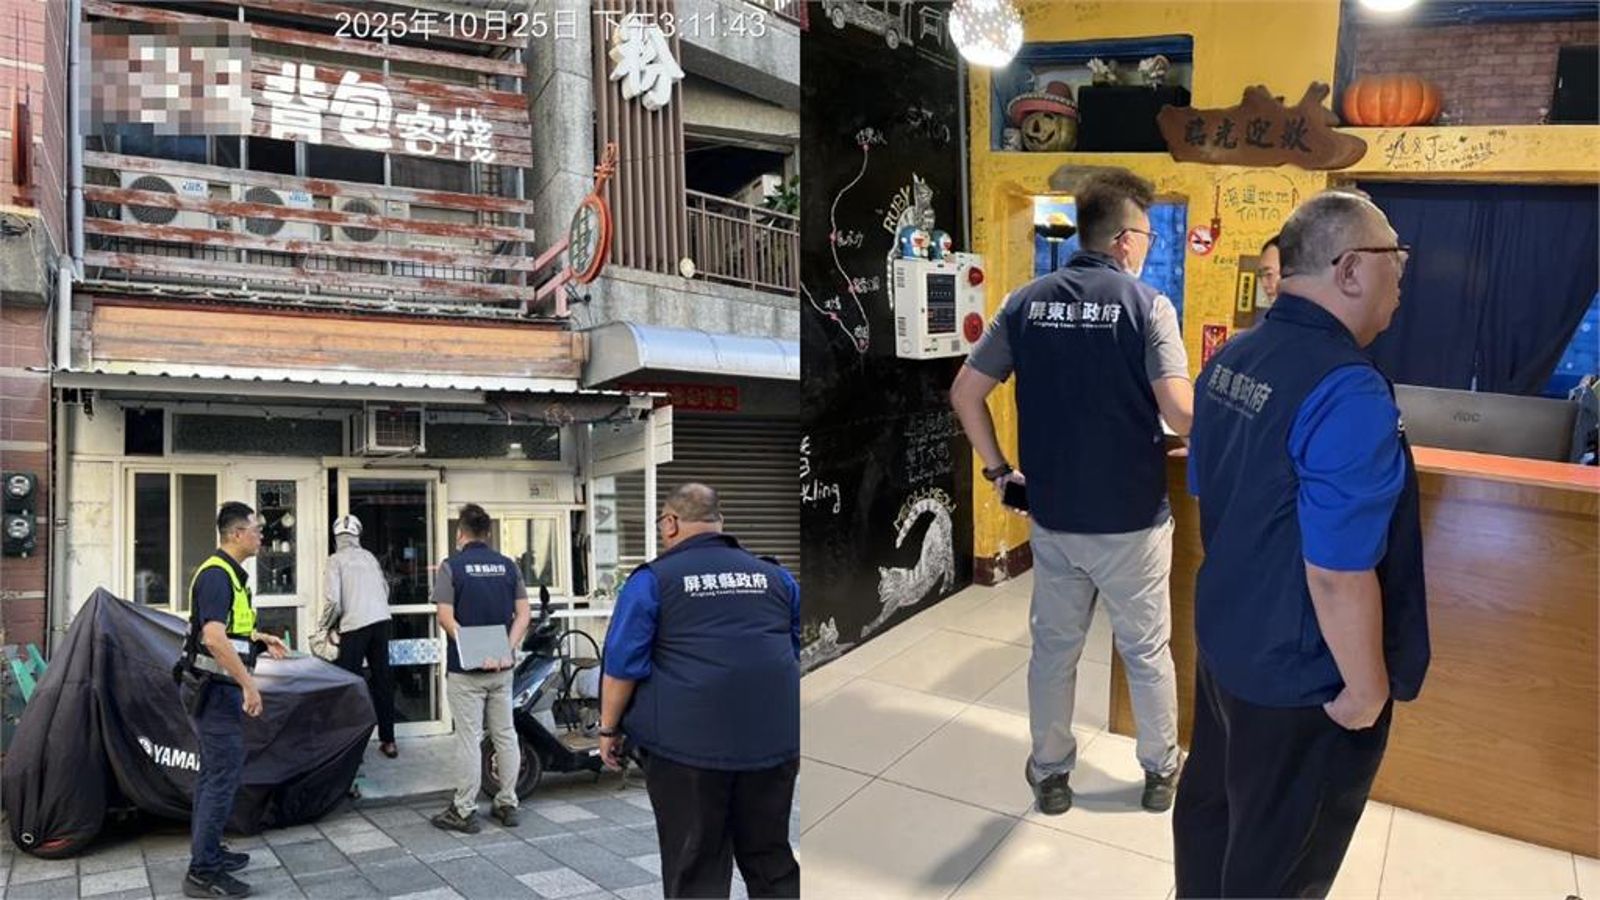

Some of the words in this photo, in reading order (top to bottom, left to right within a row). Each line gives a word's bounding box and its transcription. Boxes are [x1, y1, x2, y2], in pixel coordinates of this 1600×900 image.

[262, 61, 496, 163] 背包客棧
[883, 185, 911, 235] RUBY
[1028, 300, 1121, 323] 屏東縣政府
[683, 572, 768, 592] 屏東縣政府
